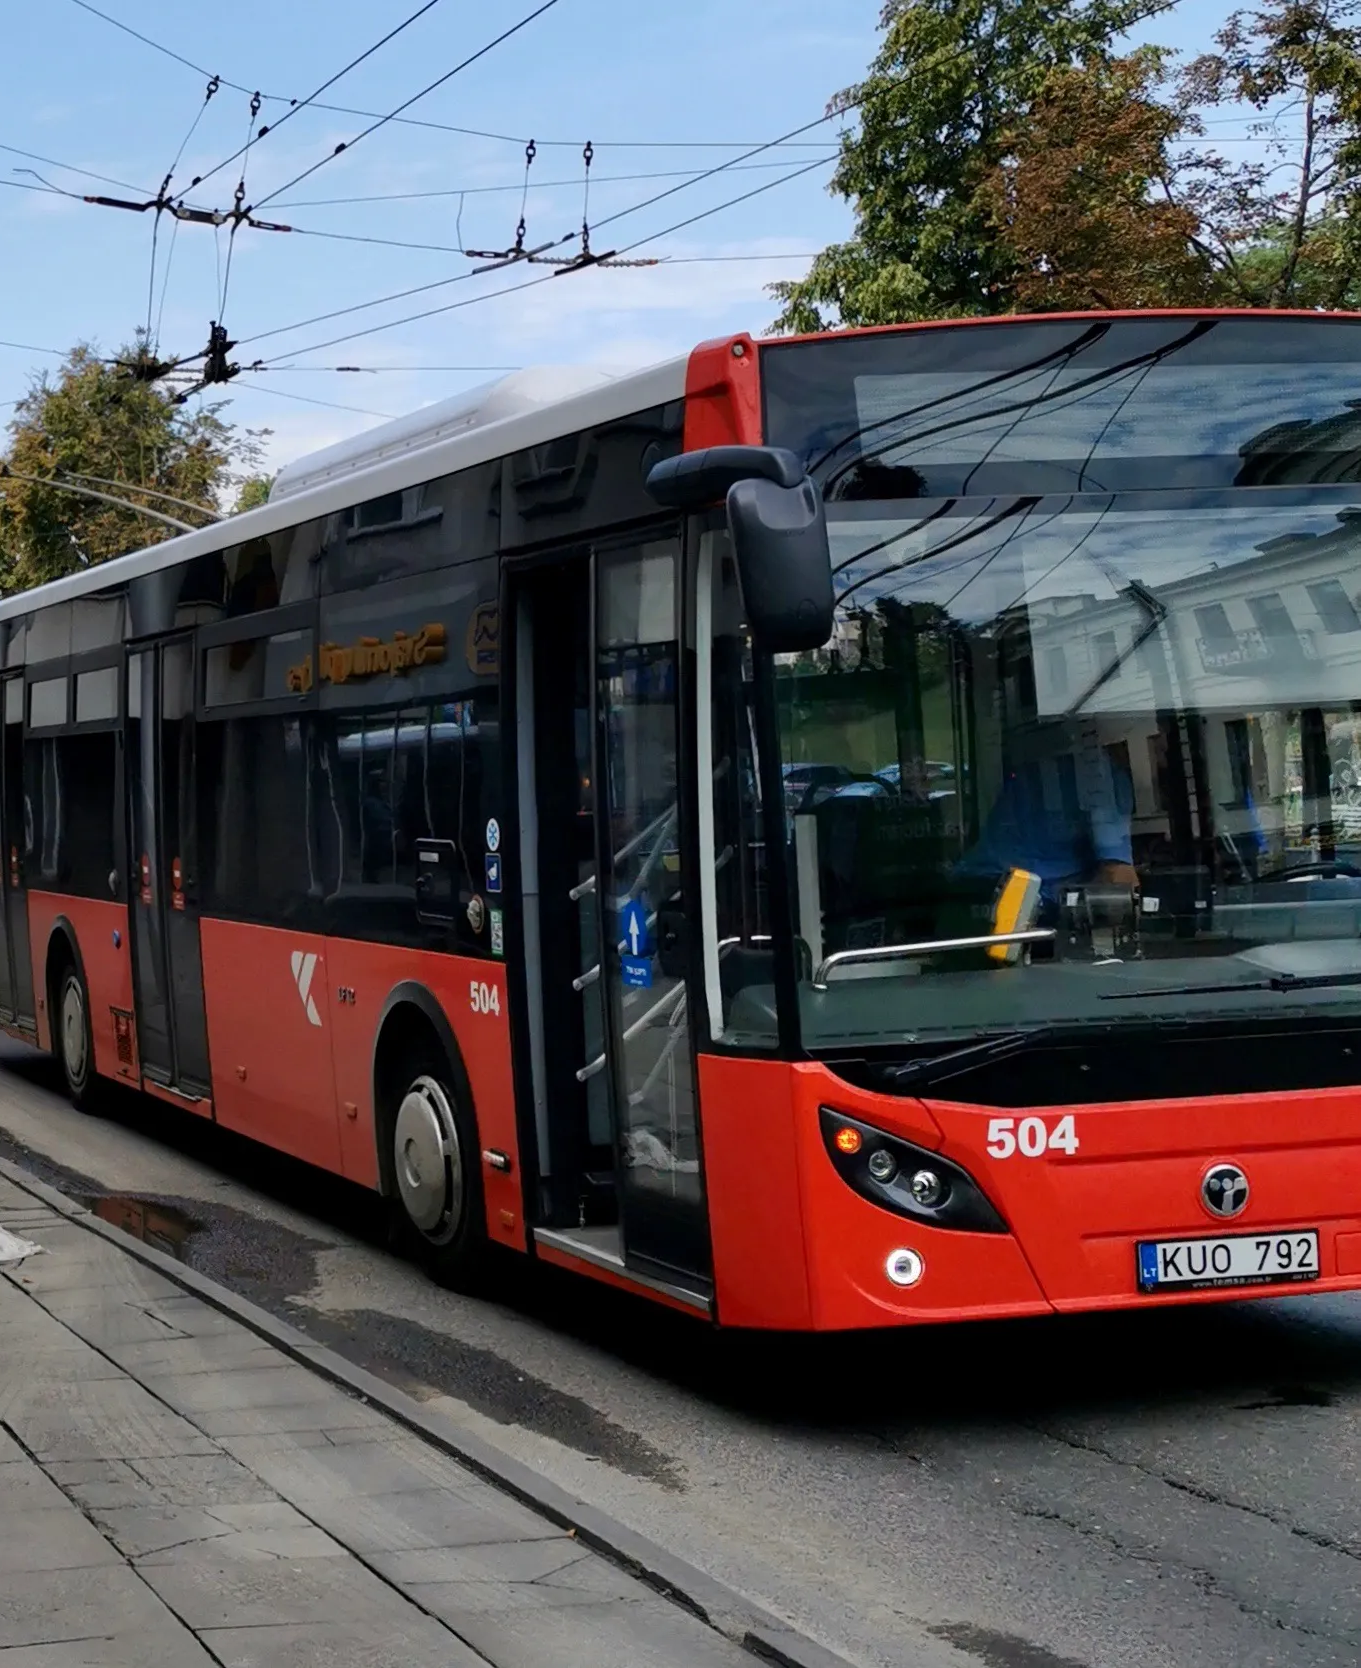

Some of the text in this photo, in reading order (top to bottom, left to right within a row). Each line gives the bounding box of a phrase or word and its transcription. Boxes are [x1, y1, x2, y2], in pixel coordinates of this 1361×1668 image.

[470, 980, 501, 1016] 504
[986, 1114, 1080, 1159] 504
[1143, 1267, 1157, 1278] LT
[1161, 1237, 1313, 1278] KUO 792
